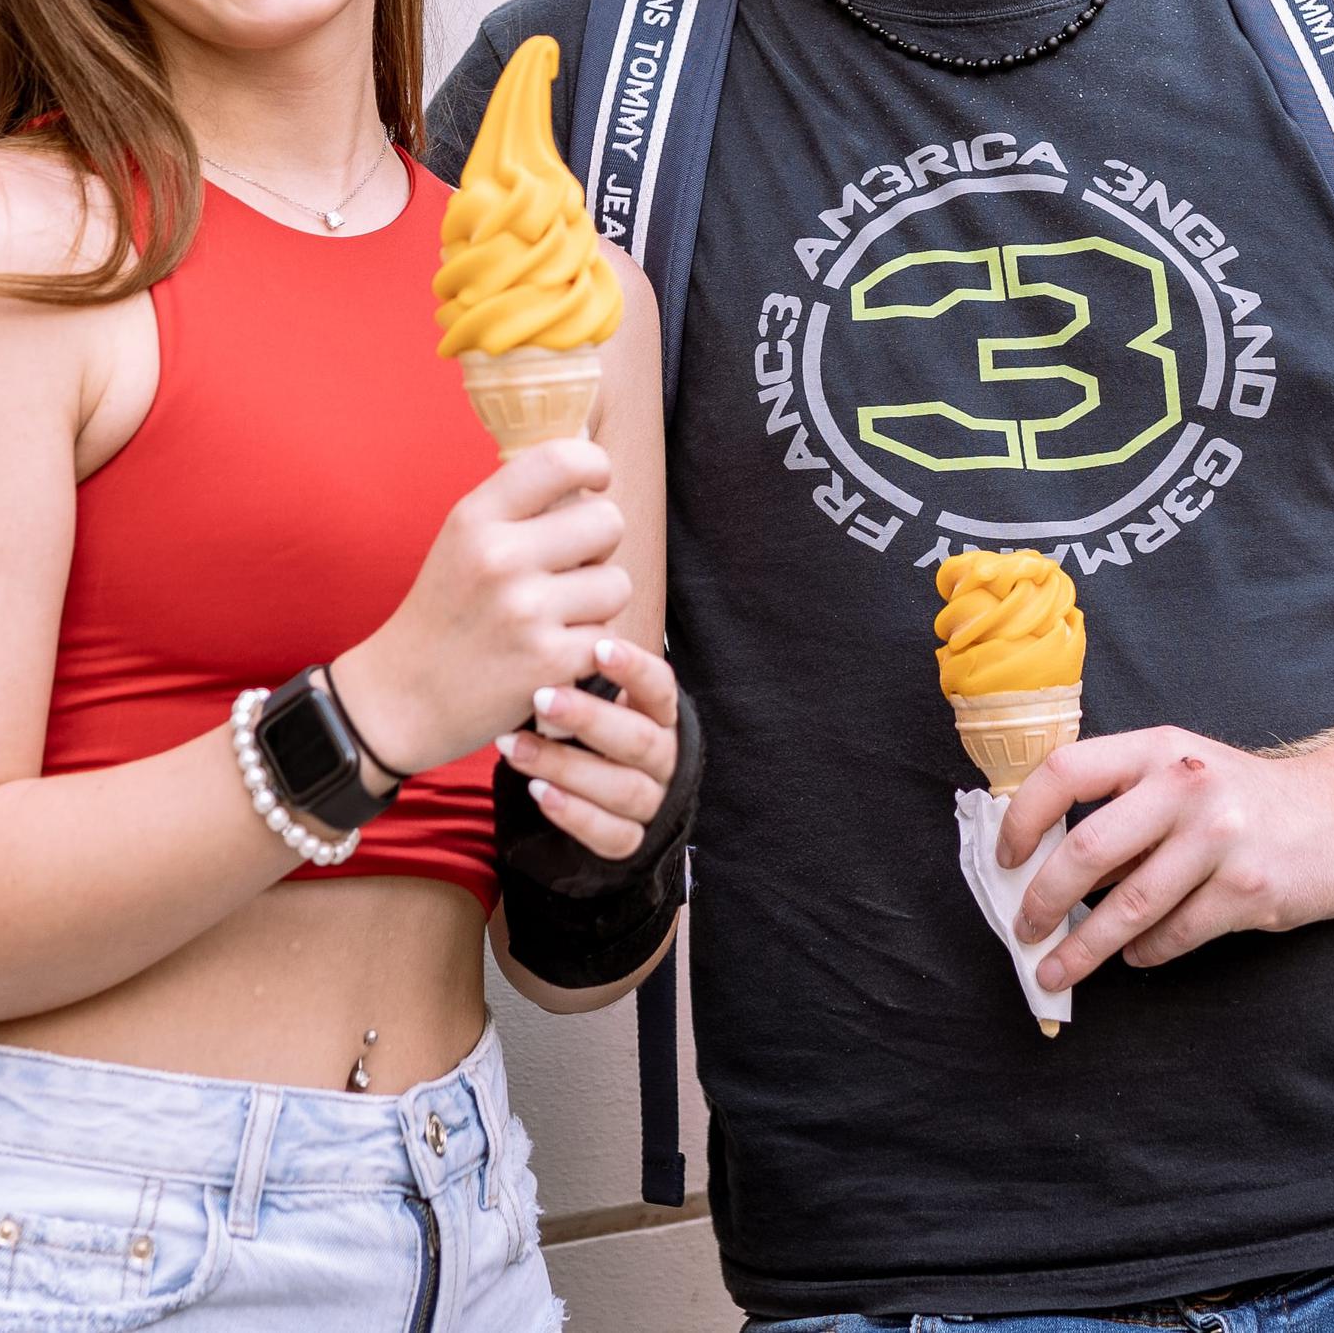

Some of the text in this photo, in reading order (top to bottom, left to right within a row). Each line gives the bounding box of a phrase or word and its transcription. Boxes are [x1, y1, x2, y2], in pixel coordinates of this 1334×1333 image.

[612, 40, 664, 162] TOMMY
[602, 172, 633, 253] JEA
[912, 436, 1243, 576] G3RMY
